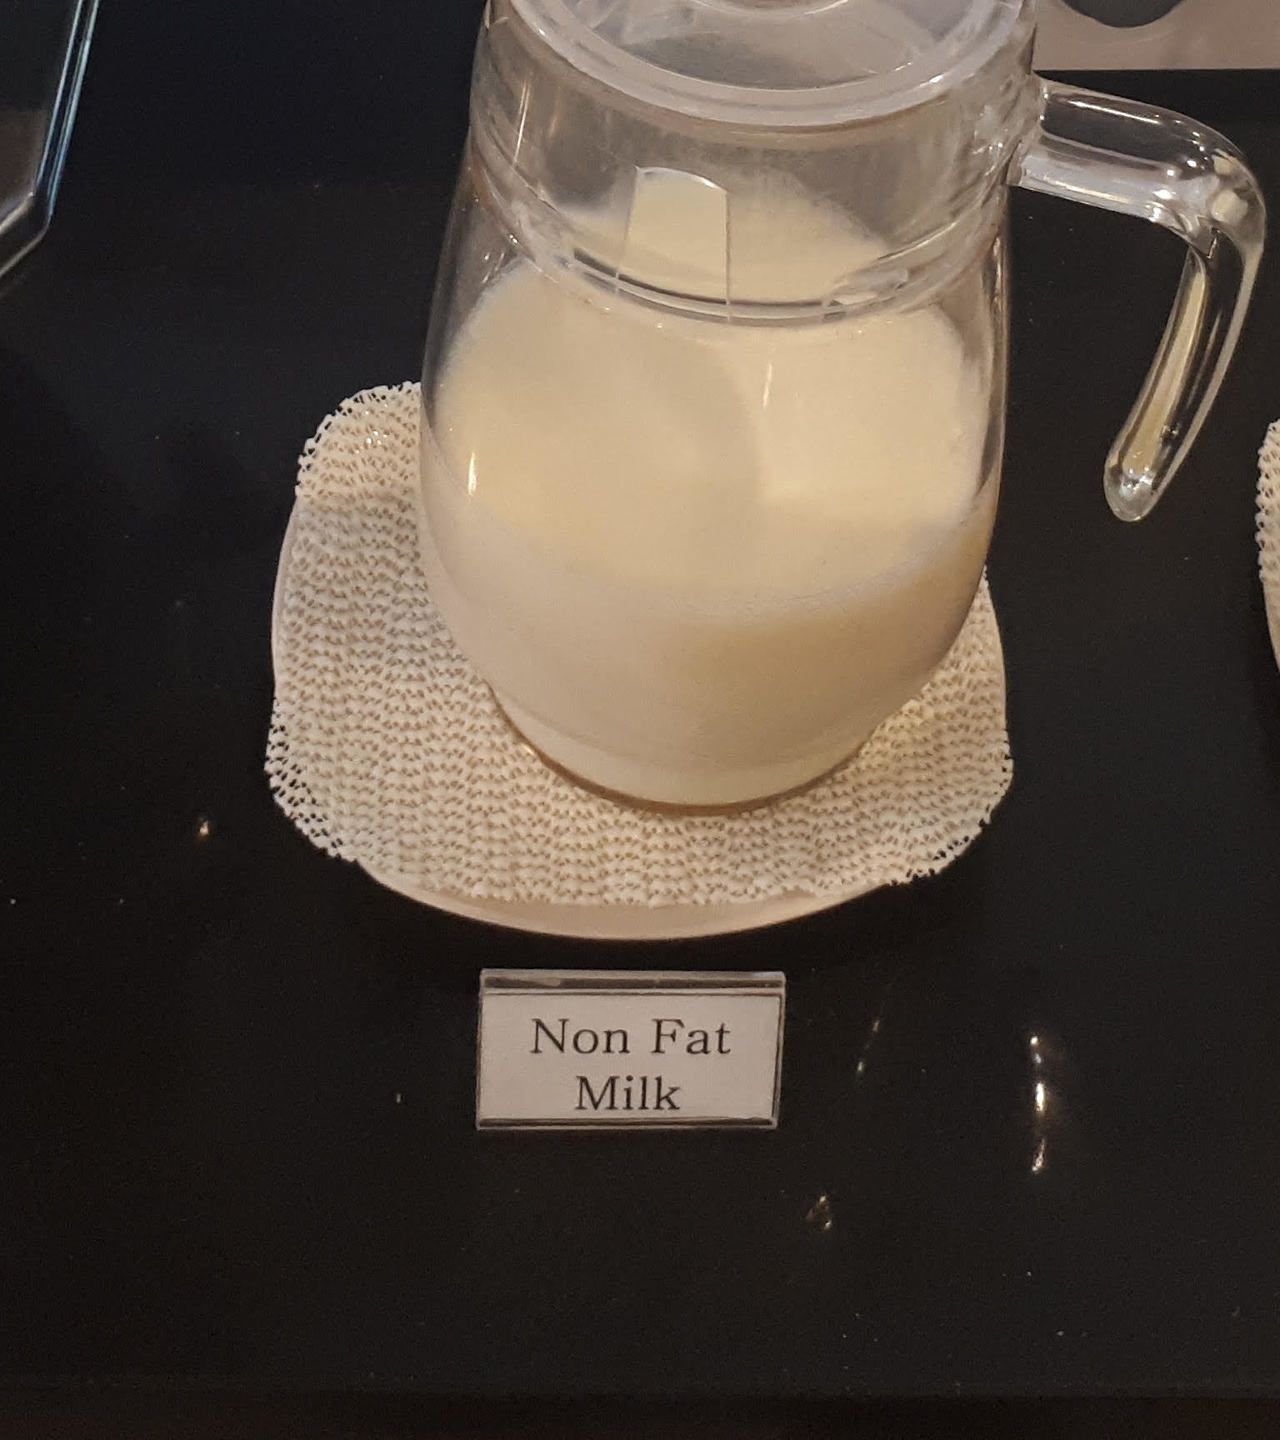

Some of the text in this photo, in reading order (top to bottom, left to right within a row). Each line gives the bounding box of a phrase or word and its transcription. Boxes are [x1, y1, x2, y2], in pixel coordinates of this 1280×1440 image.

[530, 1018, 732, 1055] Non Fat
[574, 1074, 680, 1111] Milk
